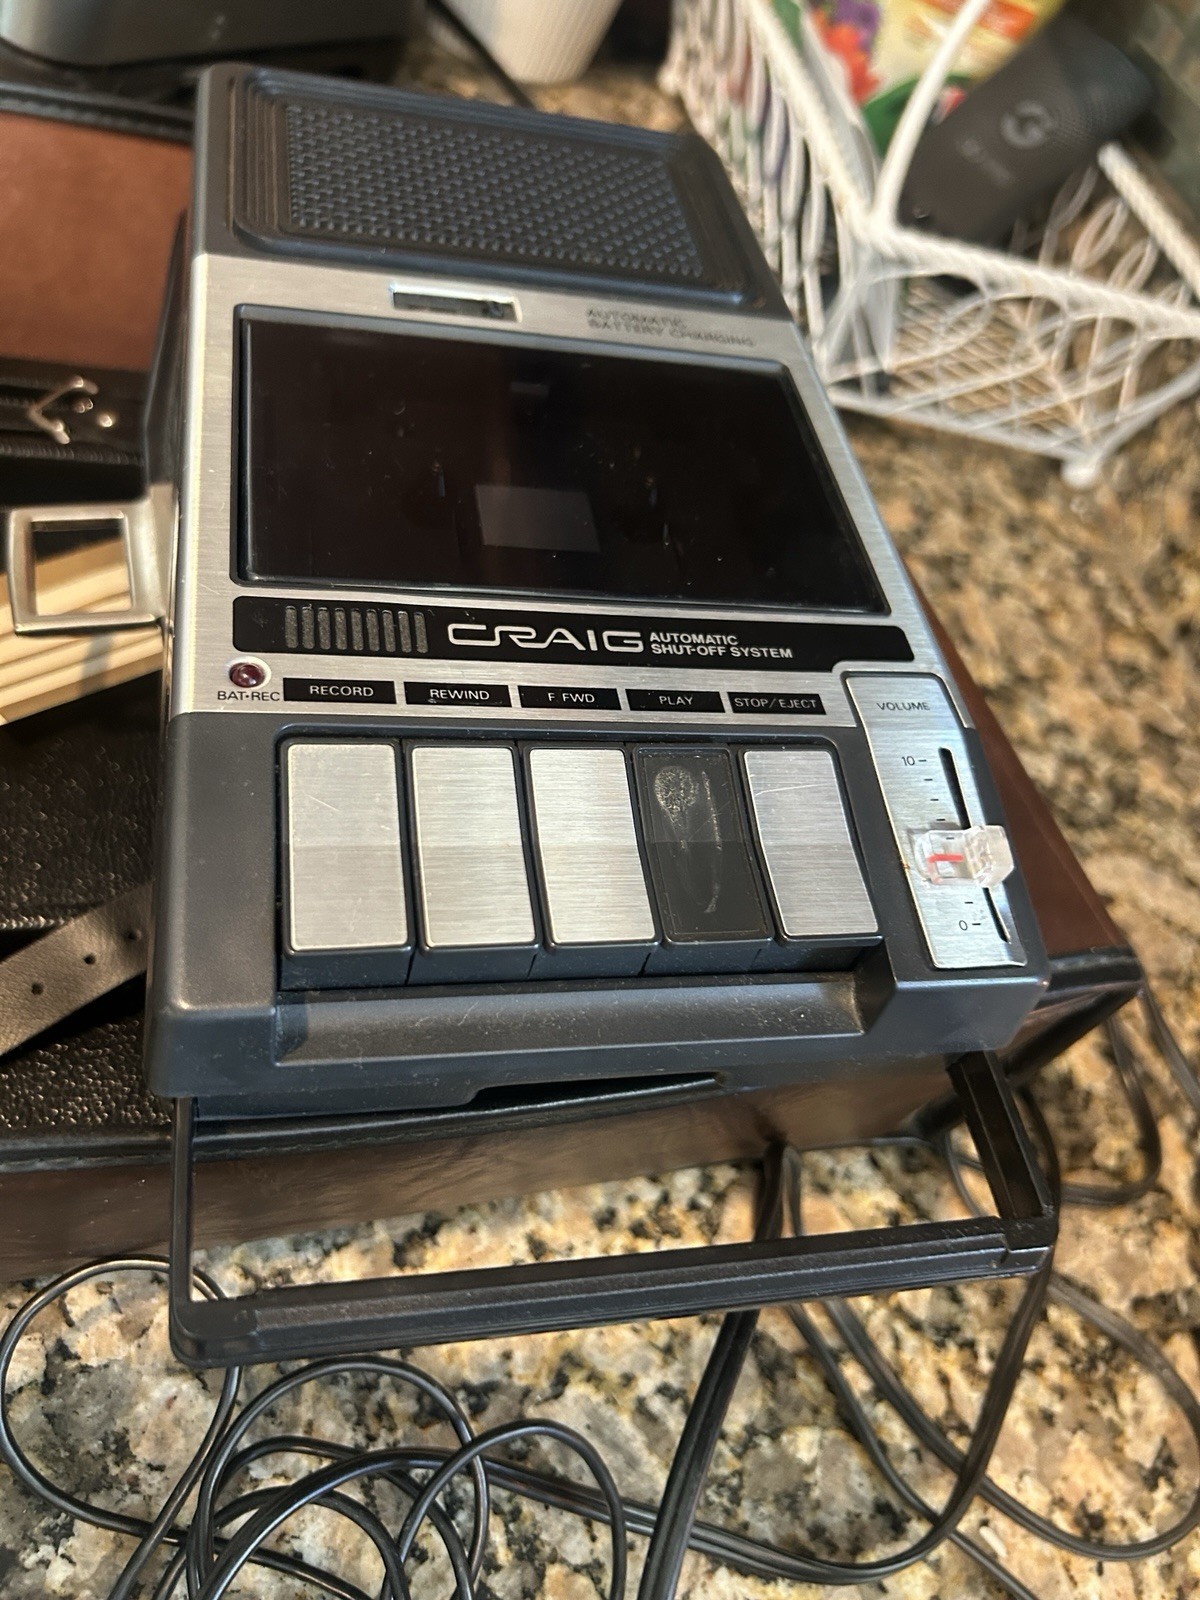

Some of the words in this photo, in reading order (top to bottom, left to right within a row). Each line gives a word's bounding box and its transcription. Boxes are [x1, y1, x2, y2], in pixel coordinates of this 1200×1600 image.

[447, 623, 644, 653] CRAIG
[649, 632, 739, 646] AUTOMATIC
[651, 643, 727, 656] SHUT-OFF
[729, 646, 793, 659] SYSTEM
[309, 685, 374, 697] RECORD
[429, 688, 490, 701] REWIND
[547, 692, 556, 702] F
[562, 692, 595, 703] FWD
[658, 695, 694, 706] PLAY
[733, 697, 818, 709] STOP/EJECT
[876, 701, 931, 712] VOLUME
[901, 755, 916, 767] 10
[958, 919, 968, 931] 0
